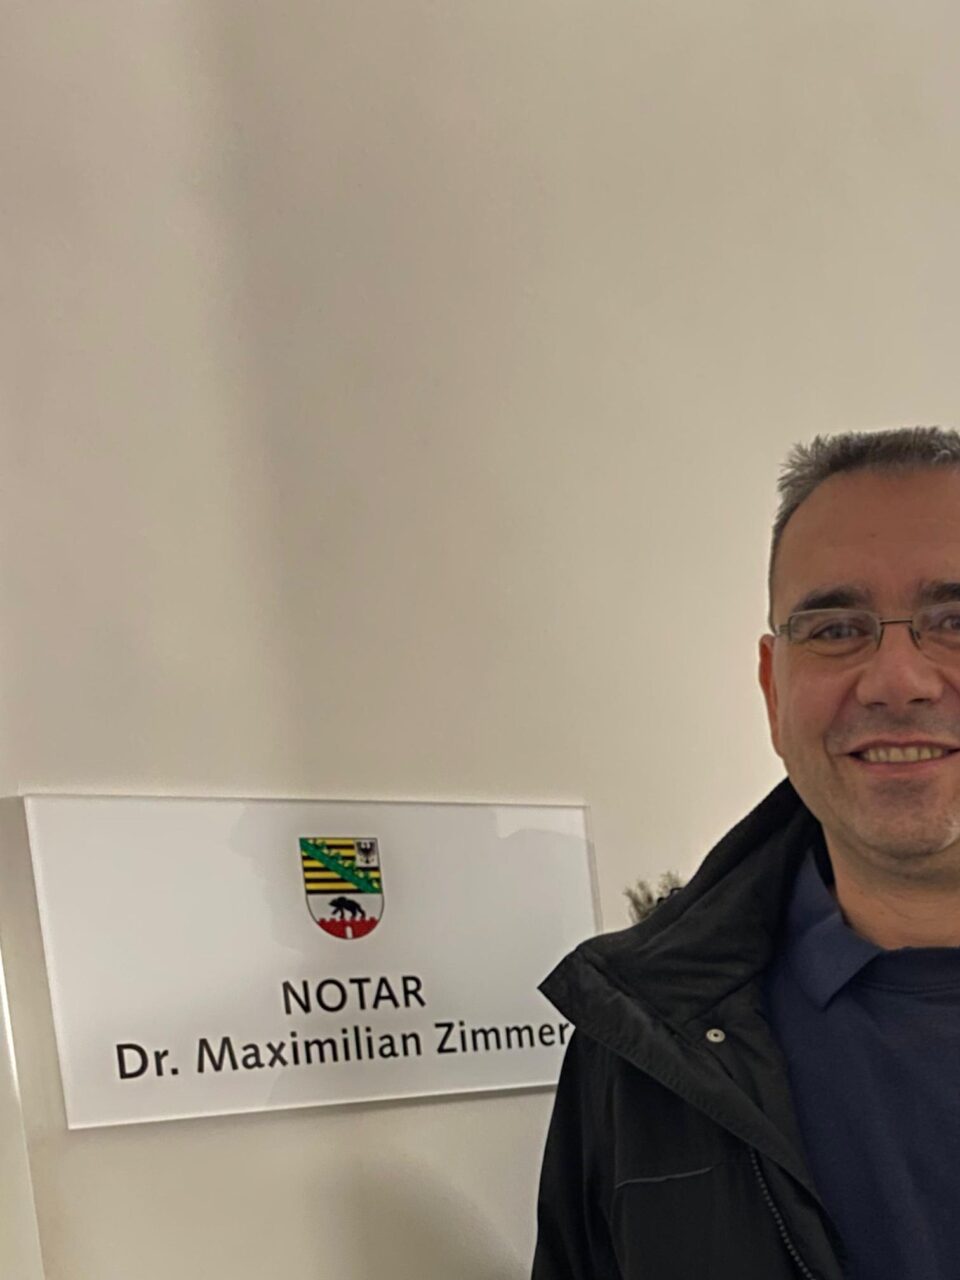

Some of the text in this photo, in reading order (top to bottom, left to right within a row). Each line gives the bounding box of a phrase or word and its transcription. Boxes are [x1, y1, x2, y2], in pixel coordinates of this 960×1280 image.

[282, 975, 426, 1015] NOTAR
[116, 1021, 570, 1080] Dr. Maximilian Zimmer
